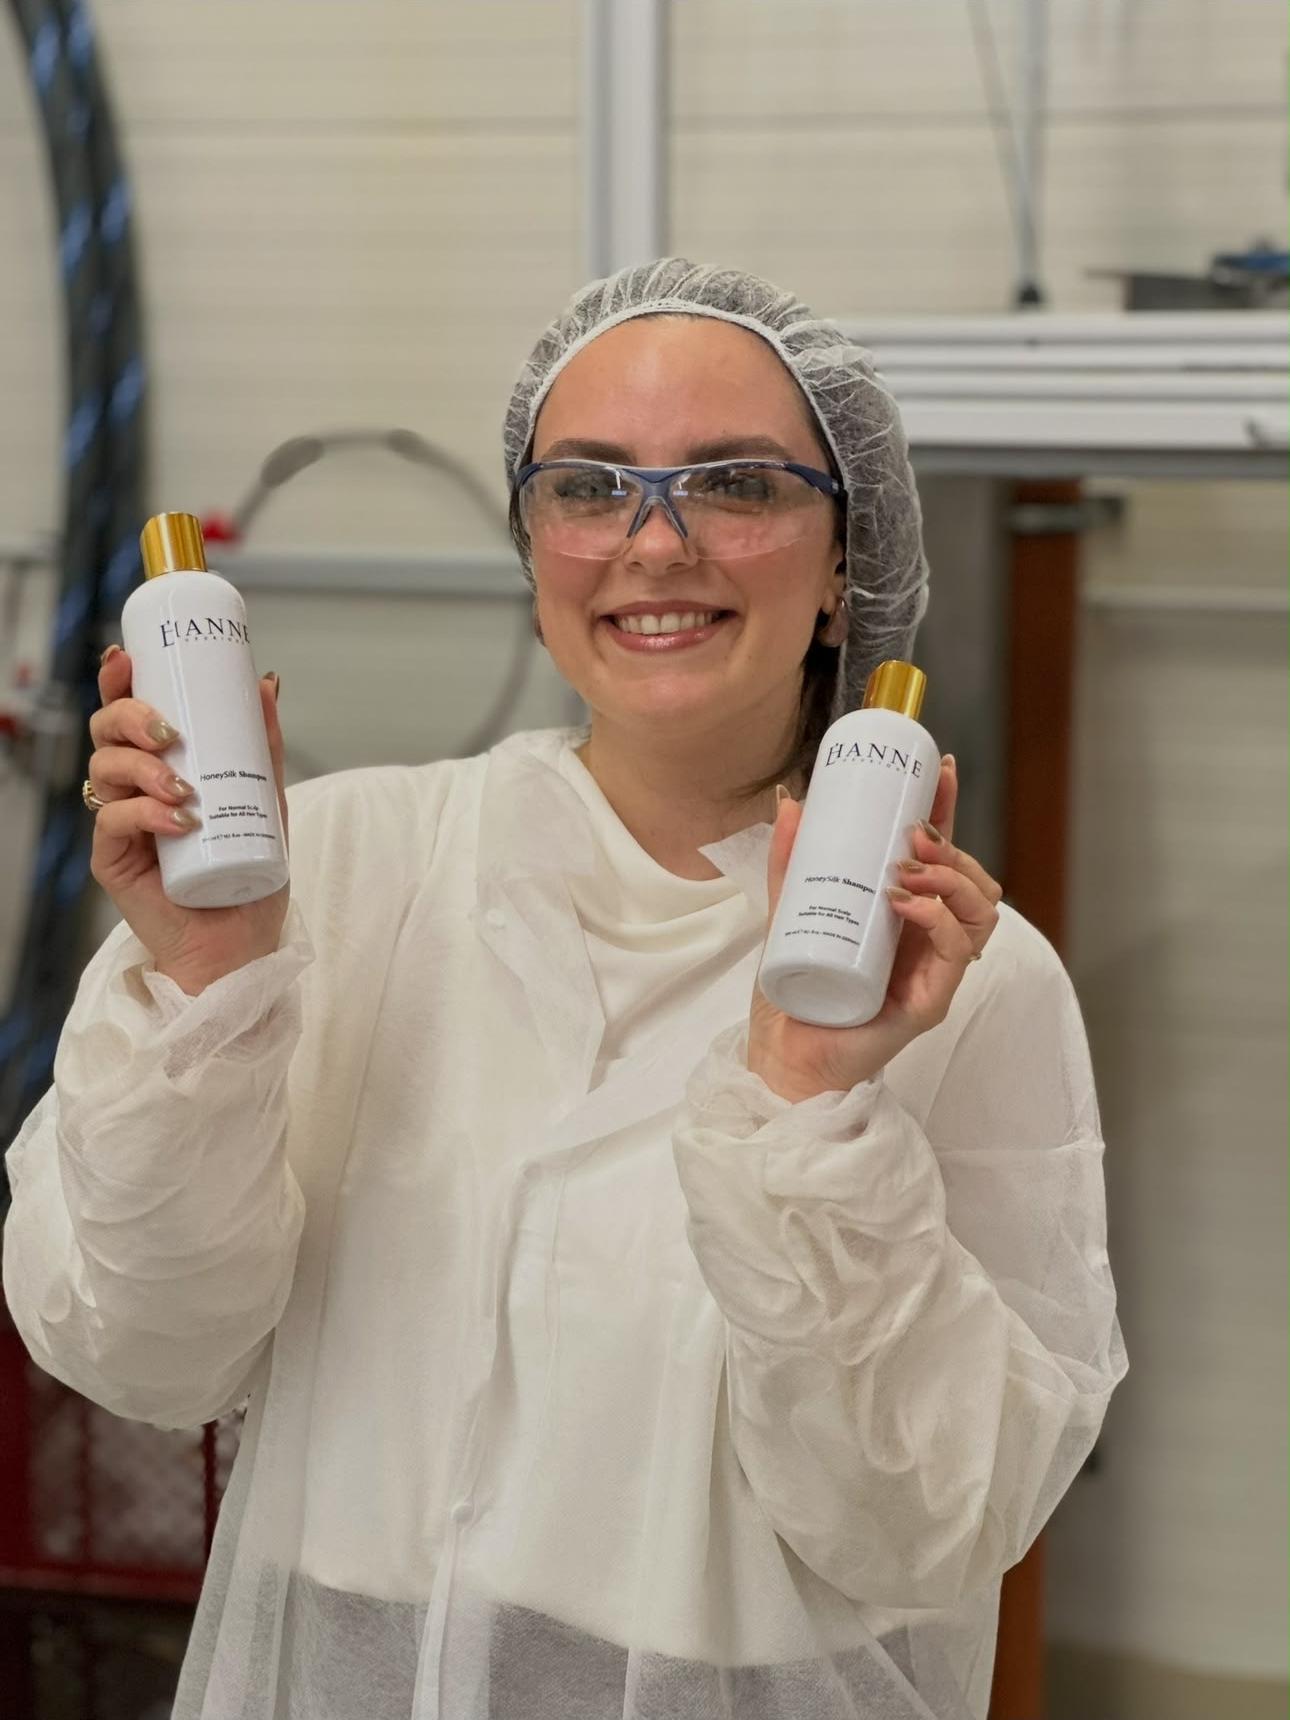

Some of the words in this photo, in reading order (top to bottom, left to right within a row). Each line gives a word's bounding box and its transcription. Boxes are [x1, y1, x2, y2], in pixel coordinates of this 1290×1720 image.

[818, 905, 837, 913] Normal
[837, 908, 852, 917] Scalp
[845, 916, 860, 926] Types
